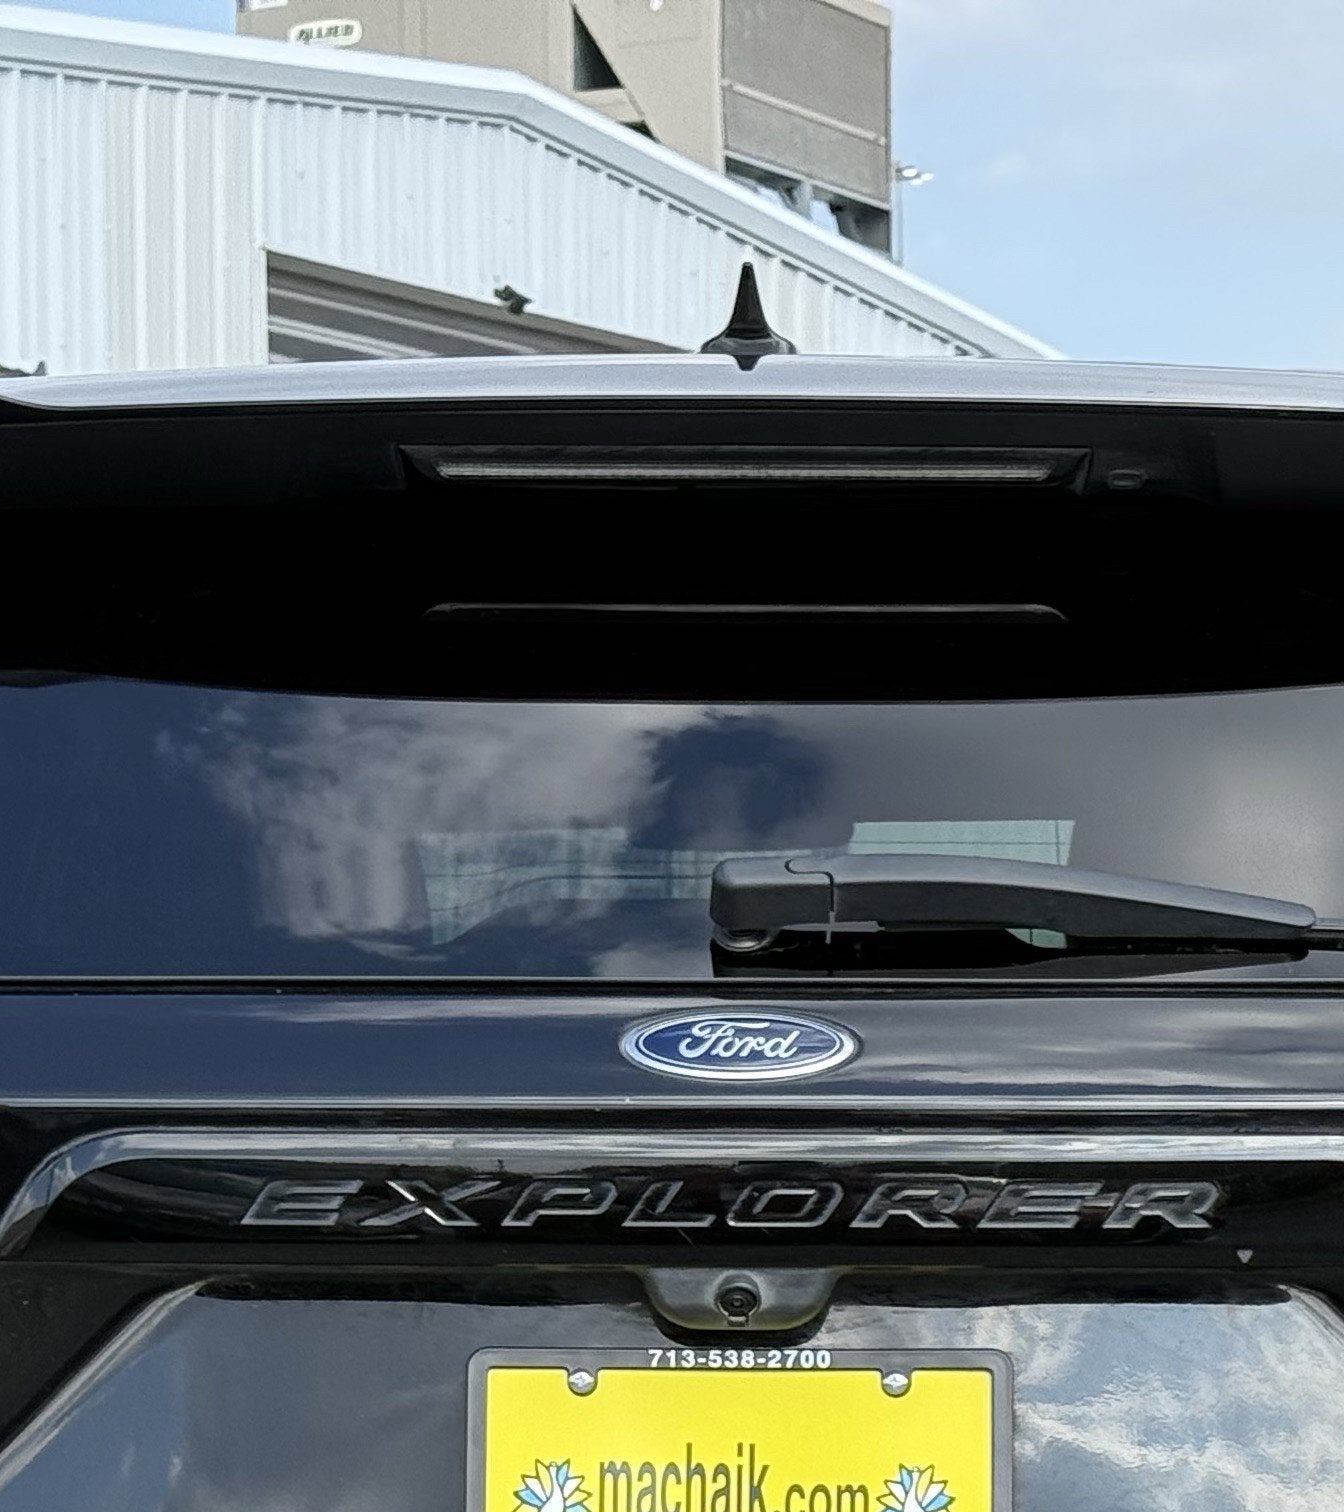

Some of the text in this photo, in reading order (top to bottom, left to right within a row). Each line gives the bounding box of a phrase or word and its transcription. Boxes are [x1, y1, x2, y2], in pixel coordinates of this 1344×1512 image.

[678, 1020, 801, 1058] Ford
[240, 1179, 1224, 1230] EXPLORER
[648, 1349, 832, 1369] 713-538-2700
